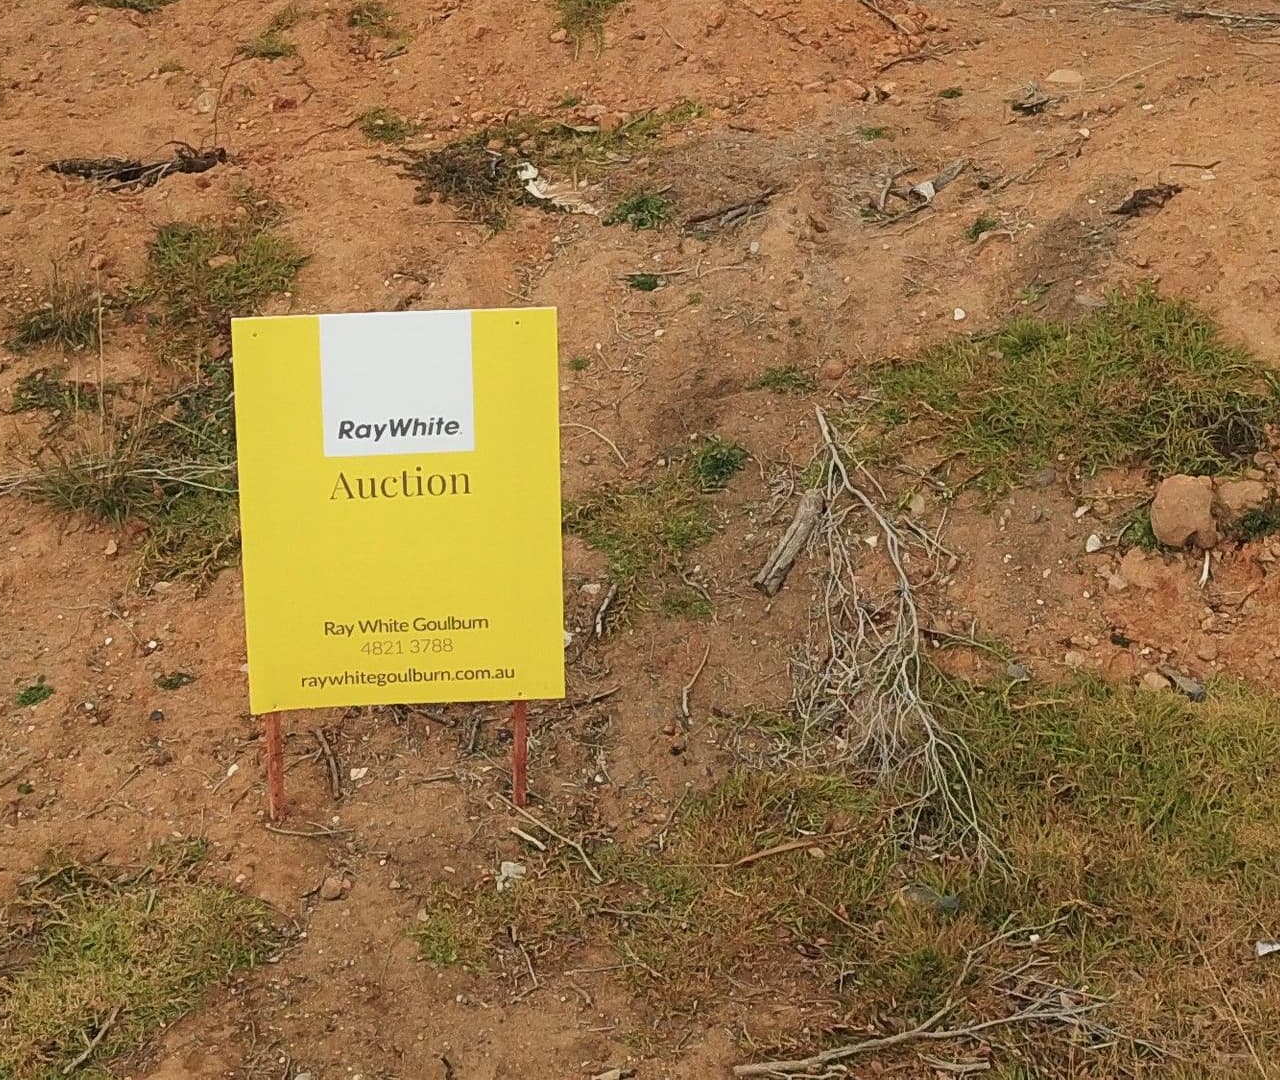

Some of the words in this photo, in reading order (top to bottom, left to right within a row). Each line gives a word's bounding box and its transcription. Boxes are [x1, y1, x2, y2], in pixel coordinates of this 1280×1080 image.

[329, 467, 472, 500] Auction
[324, 621, 354, 637] Ray
[358, 618, 410, 634] White
[412, 616, 489, 632] Goulburn
[360, 640, 403, 656] 4821
[409, 638, 454, 654] 3788
[301, 667, 516, 689] raywhitegoulburn.com.au
